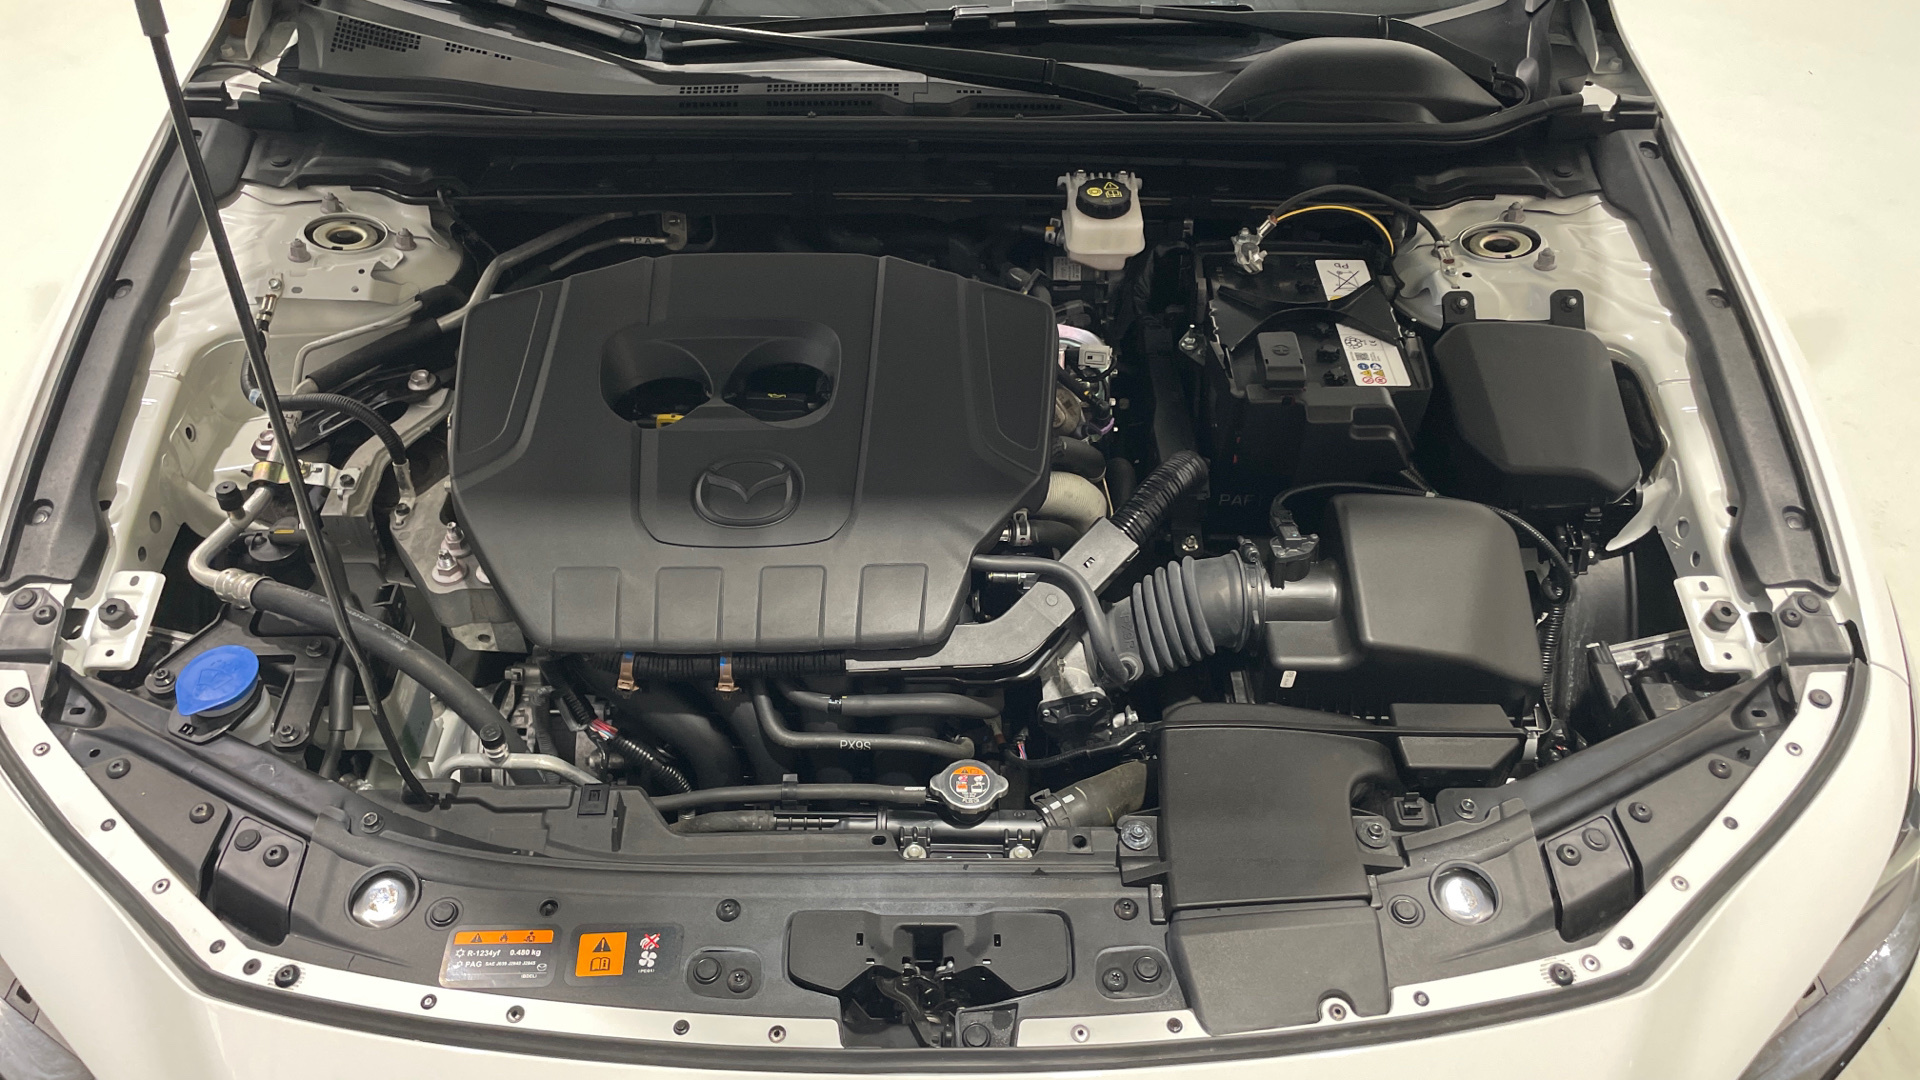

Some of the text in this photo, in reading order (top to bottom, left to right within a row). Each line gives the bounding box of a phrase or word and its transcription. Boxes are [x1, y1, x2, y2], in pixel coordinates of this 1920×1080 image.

[839, 739, 872, 750] PX9S
[467, 949, 501, 958] R-1234yf
[531, 948, 541, 957] kg
